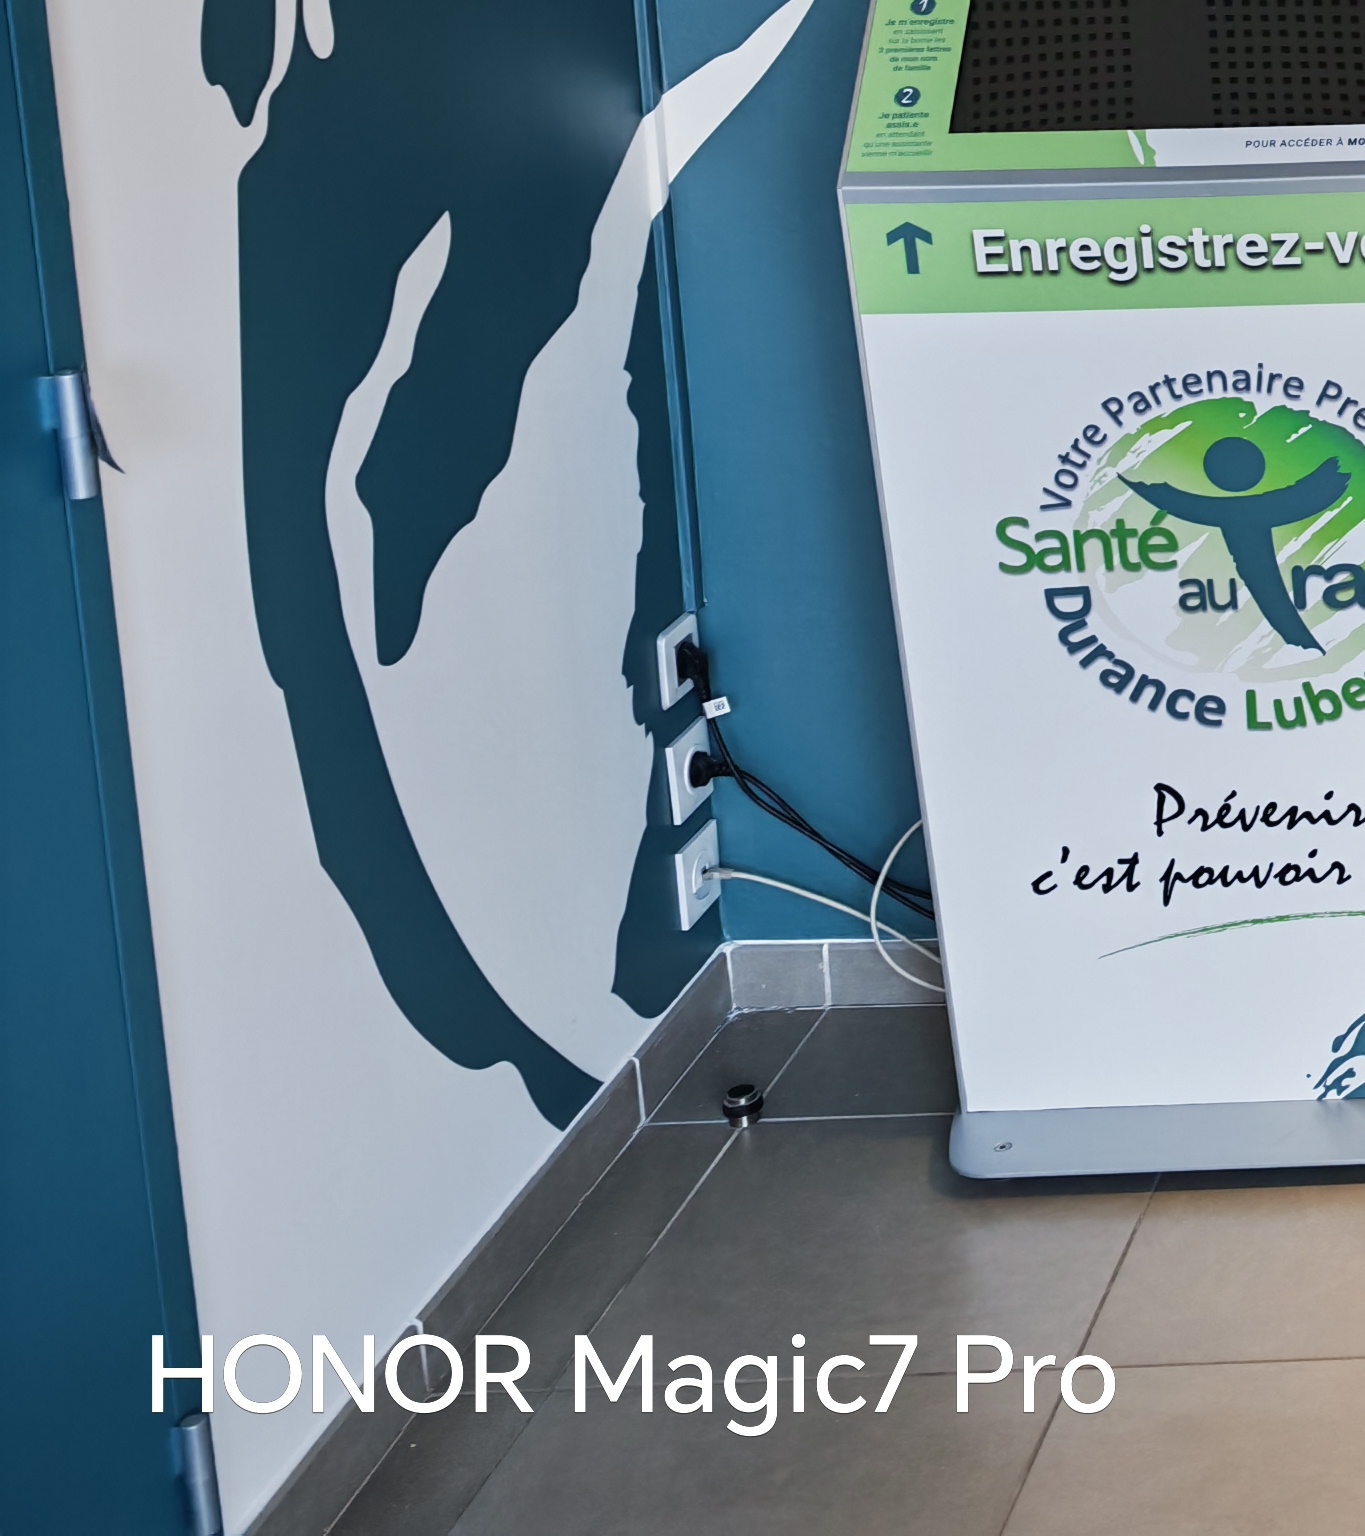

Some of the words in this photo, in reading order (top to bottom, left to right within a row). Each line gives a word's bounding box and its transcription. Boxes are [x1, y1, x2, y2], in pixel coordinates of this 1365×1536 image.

[901, 89, 913, 103] 2
[1245, 139, 1277, 149] POUR
[1279, 137, 1333, 148] ACCÉDER
[1335, 136, 1344, 146] À
[1039, 419, 1108, 514] Votre
[1102, 362, 1305, 429] Partenaire
[995, 512, 1179, 575] Santé
[1177, 573, 1238, 612] au
[1044, 586, 1227, 727] Durance
[1031, 847, 1140, 895] c'est
[1159, 849, 1351, 907] pouvoir
